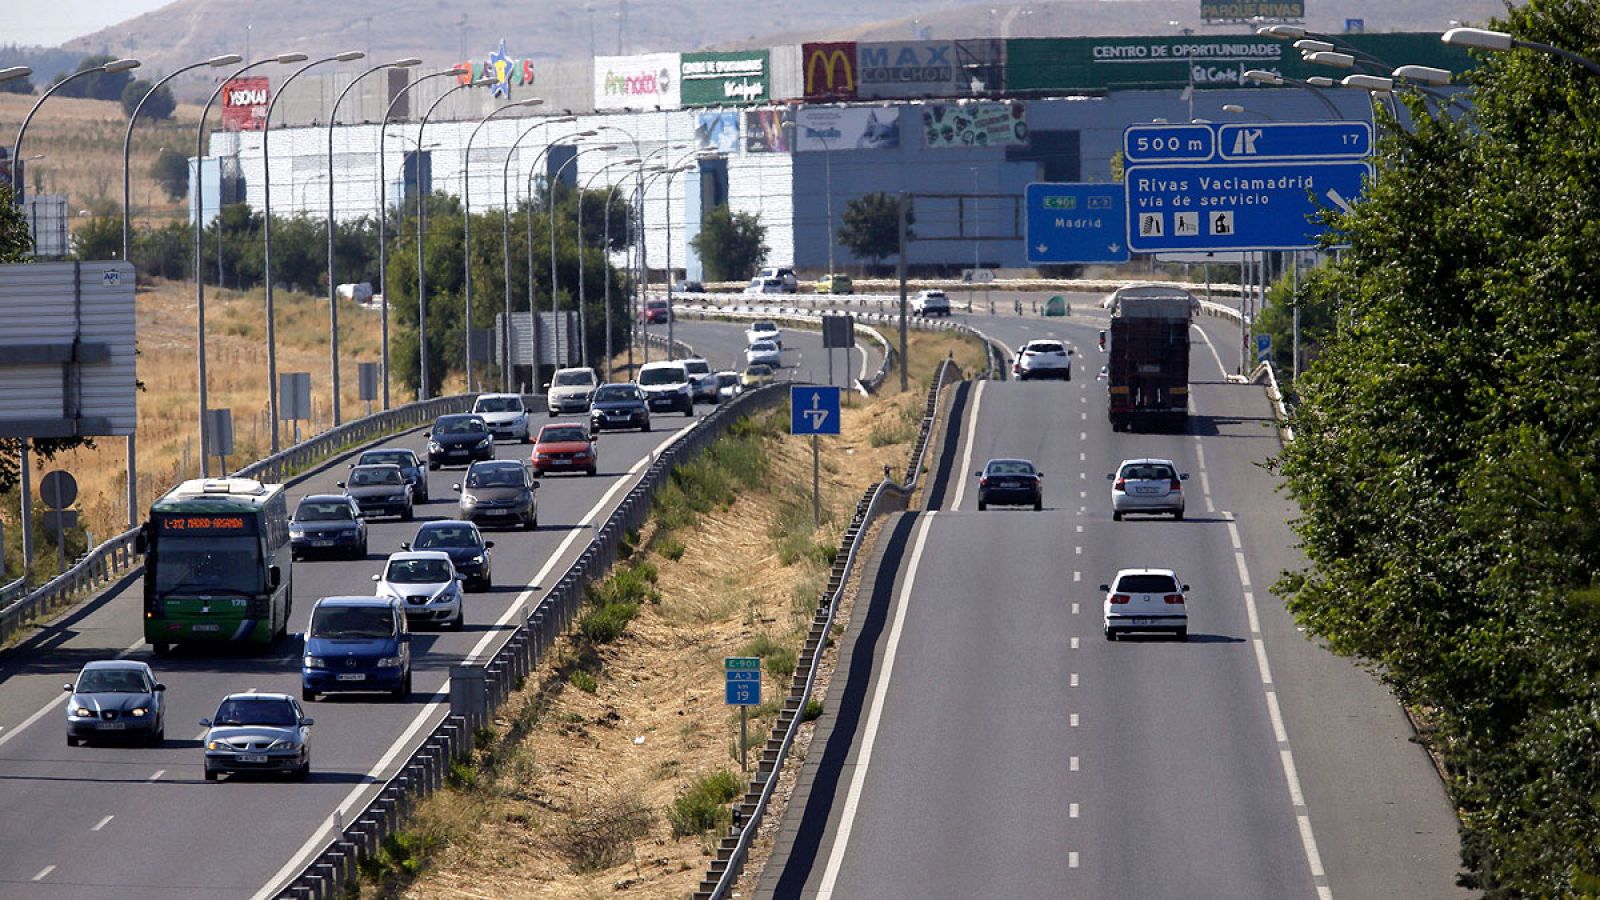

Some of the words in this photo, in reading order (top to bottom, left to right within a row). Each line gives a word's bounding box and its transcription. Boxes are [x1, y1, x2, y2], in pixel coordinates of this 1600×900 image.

[1202, 4, 1255, 16] PARQUE
[1259, 3, 1300, 16] RIVAS
[861, 46, 950, 66] MAX
[1093, 46, 1147, 57] CENTRO
[1151, 45, 1168, 56] DE
[1172, 43, 1282, 56] OPORTUNIDADES
[863, 68, 950, 81] COLCHON
[1137, 137, 1181, 151] 500
[1188, 139, 1203, 151] m
[1342, 134, 1360, 145] 17
[1138, 179, 1189, 192] Rivas
[1199, 176, 1314, 190] Vaciamadrid
[1139, 196, 1164, 207] vía
[1172, 195, 1192, 206] de
[1200, 193, 1270, 205] servicio
[1055, 218, 1102, 228] Madrid
[728, 660, 757, 668] E-901
[736, 691, 749, 701] 19
